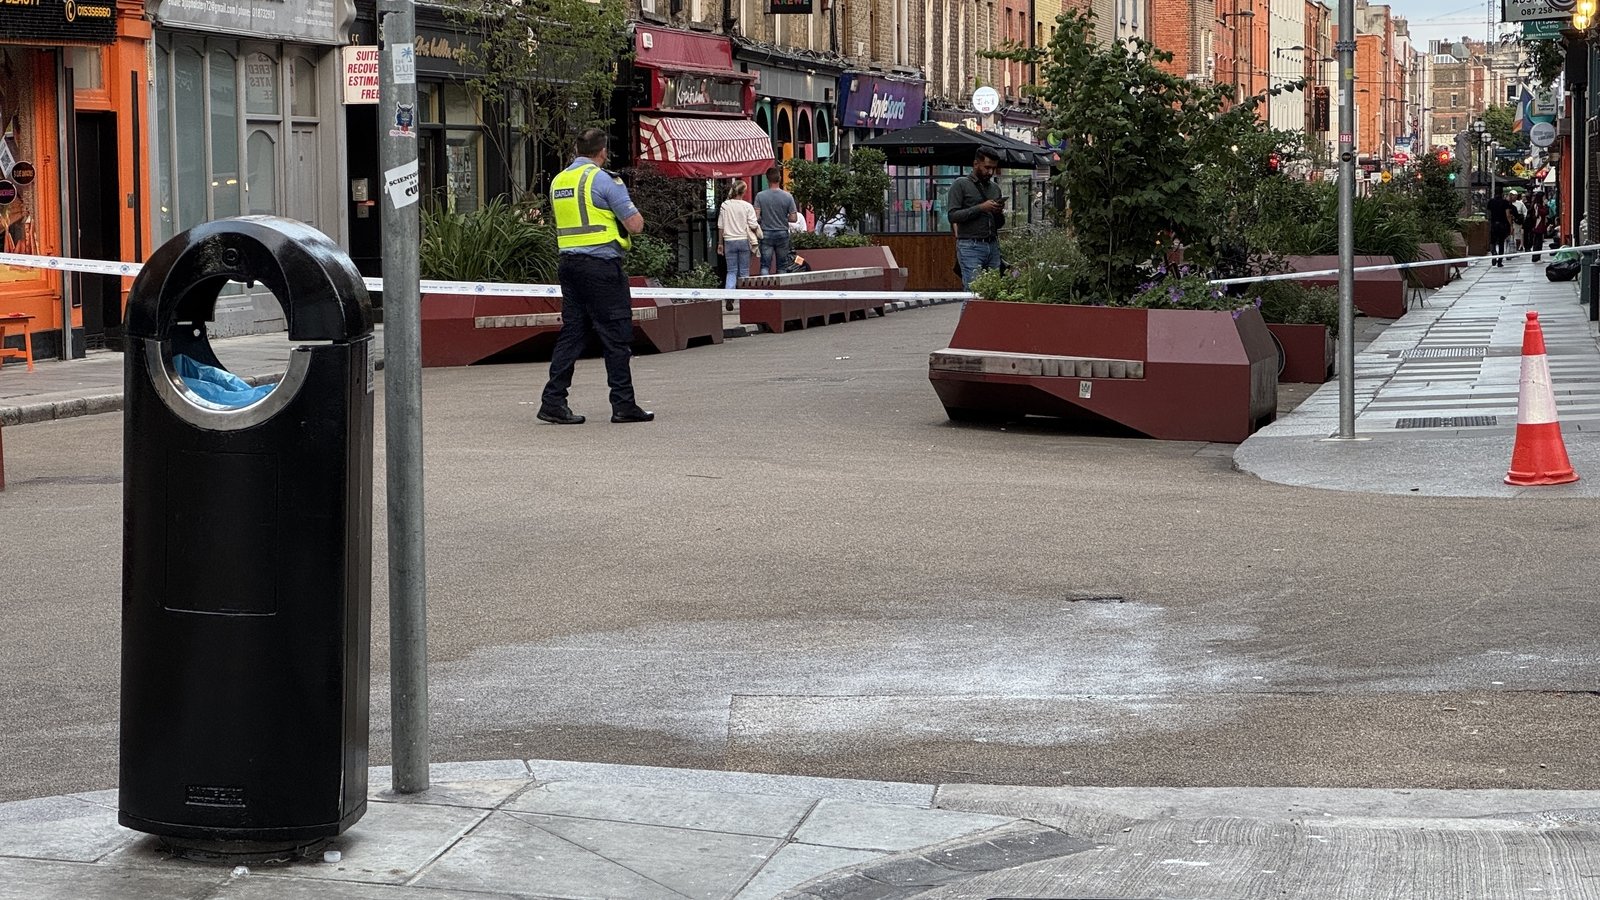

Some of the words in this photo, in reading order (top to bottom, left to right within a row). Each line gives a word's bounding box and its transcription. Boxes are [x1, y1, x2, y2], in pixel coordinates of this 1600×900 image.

[869, 92, 906, 126] BoyleSports
[899, 146, 935, 154] KREWE
[554, 189, 574, 198] GARDA
